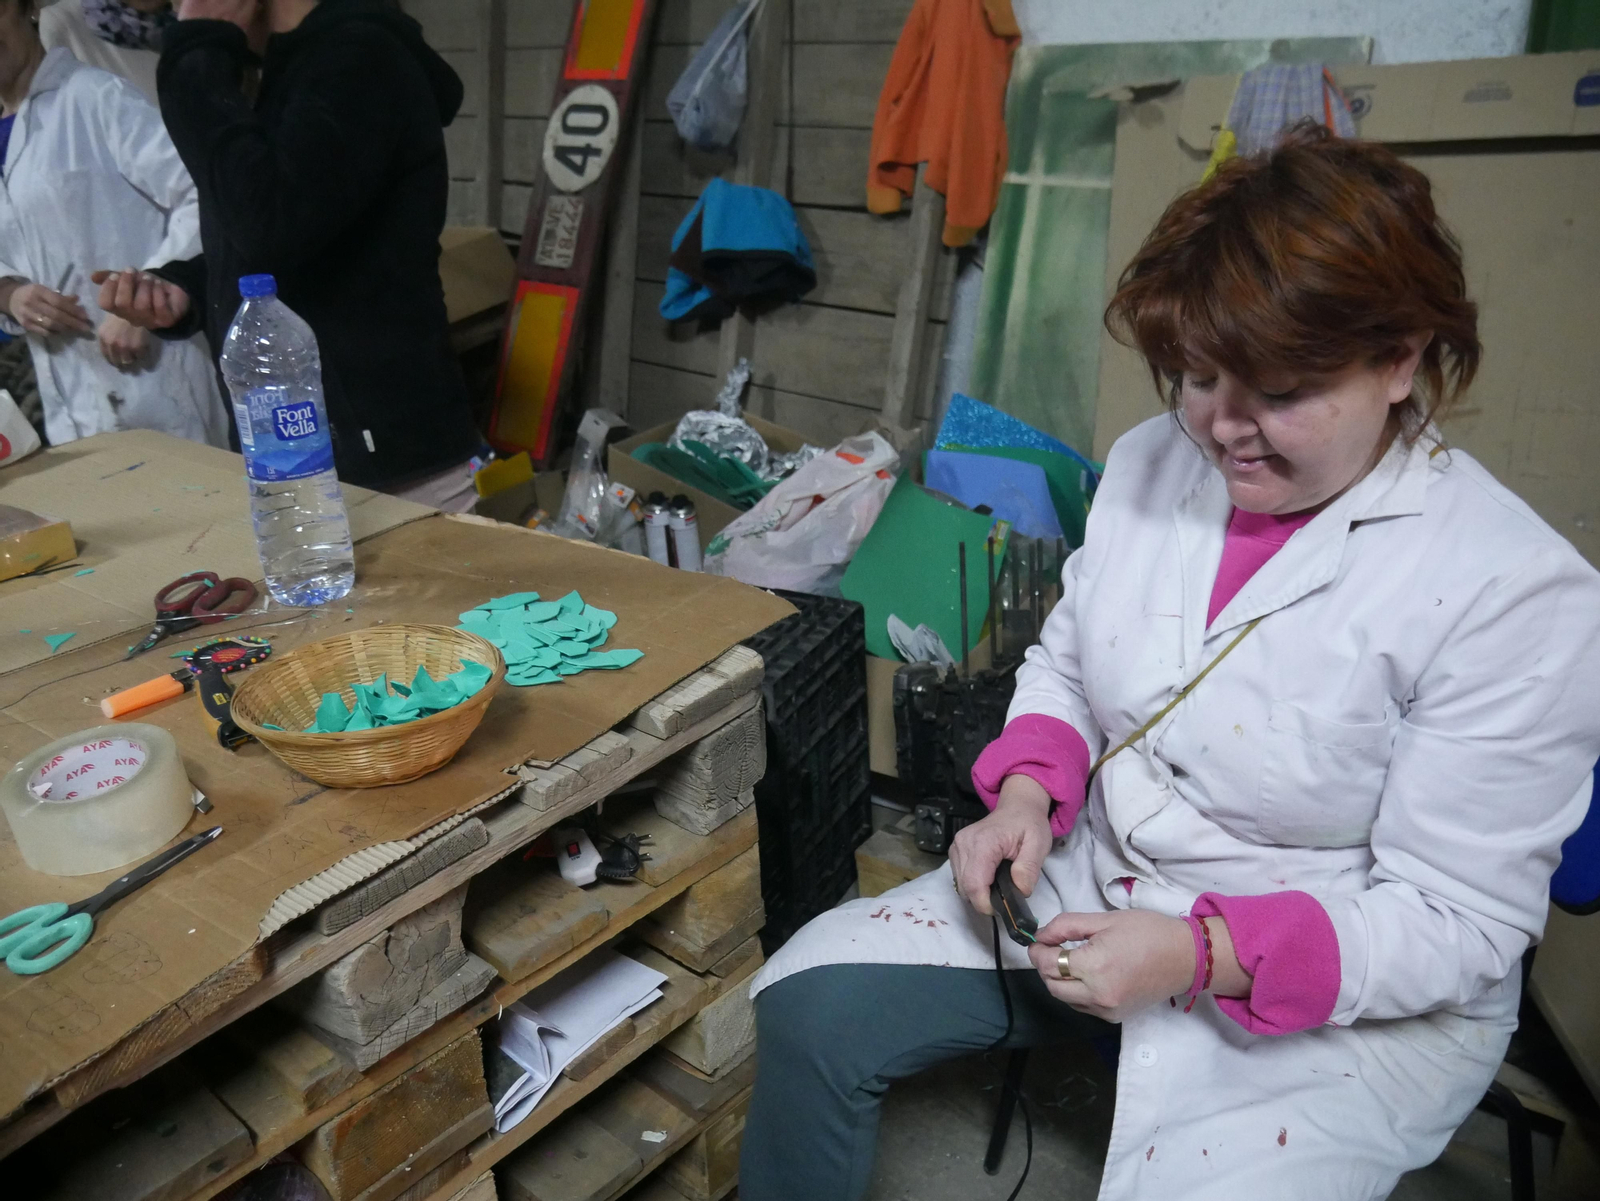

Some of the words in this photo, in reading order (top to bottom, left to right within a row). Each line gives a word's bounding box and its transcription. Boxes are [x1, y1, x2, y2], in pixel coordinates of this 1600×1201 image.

[553, 104, 609, 177] 40
[276, 405, 314, 423] Font
[278, 420, 317, 438] Vella
